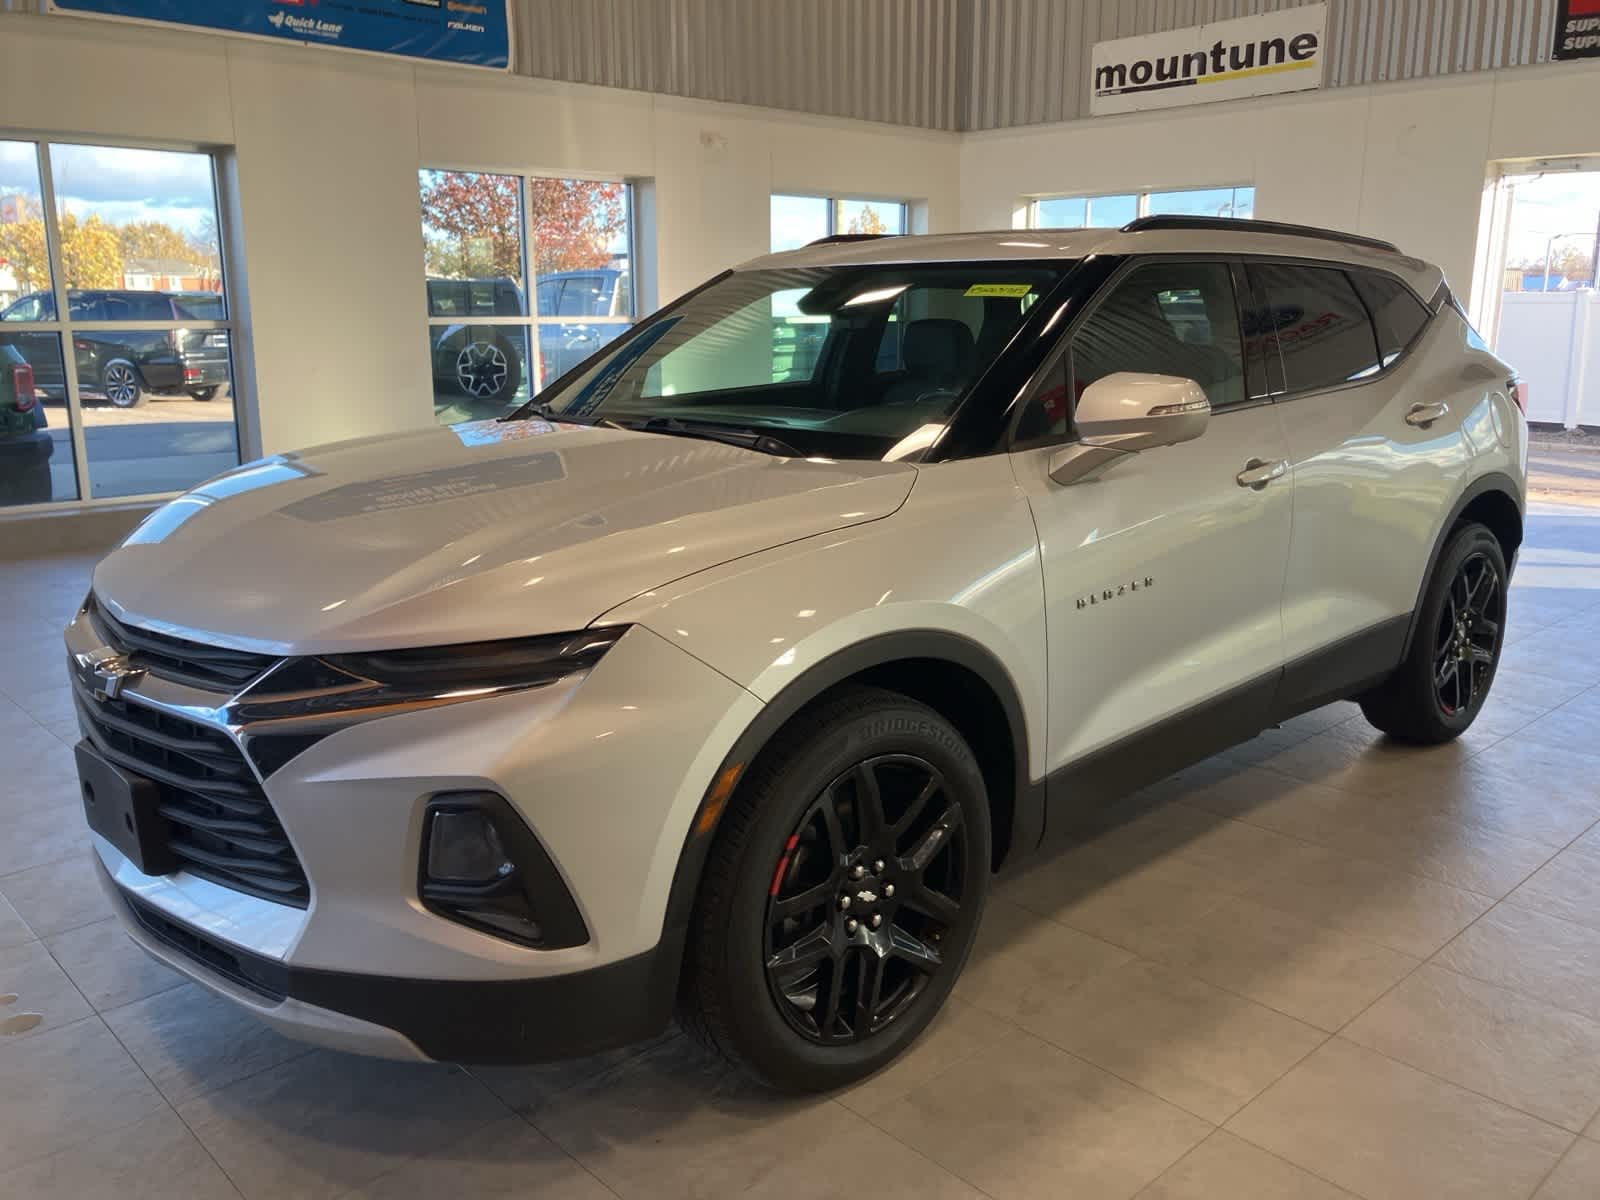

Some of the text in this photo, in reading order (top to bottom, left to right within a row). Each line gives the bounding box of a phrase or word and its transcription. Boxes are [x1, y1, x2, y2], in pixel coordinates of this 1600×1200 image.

[285, 15, 315, 29] Quick
[316, 19, 343, 33] Lane
[447, 21, 485, 33] FALKEN
[1565, 17, 1600, 33] SUP
[1095, 32, 1318, 90] mountune
[1076, 575, 1154, 610] BLAZER
